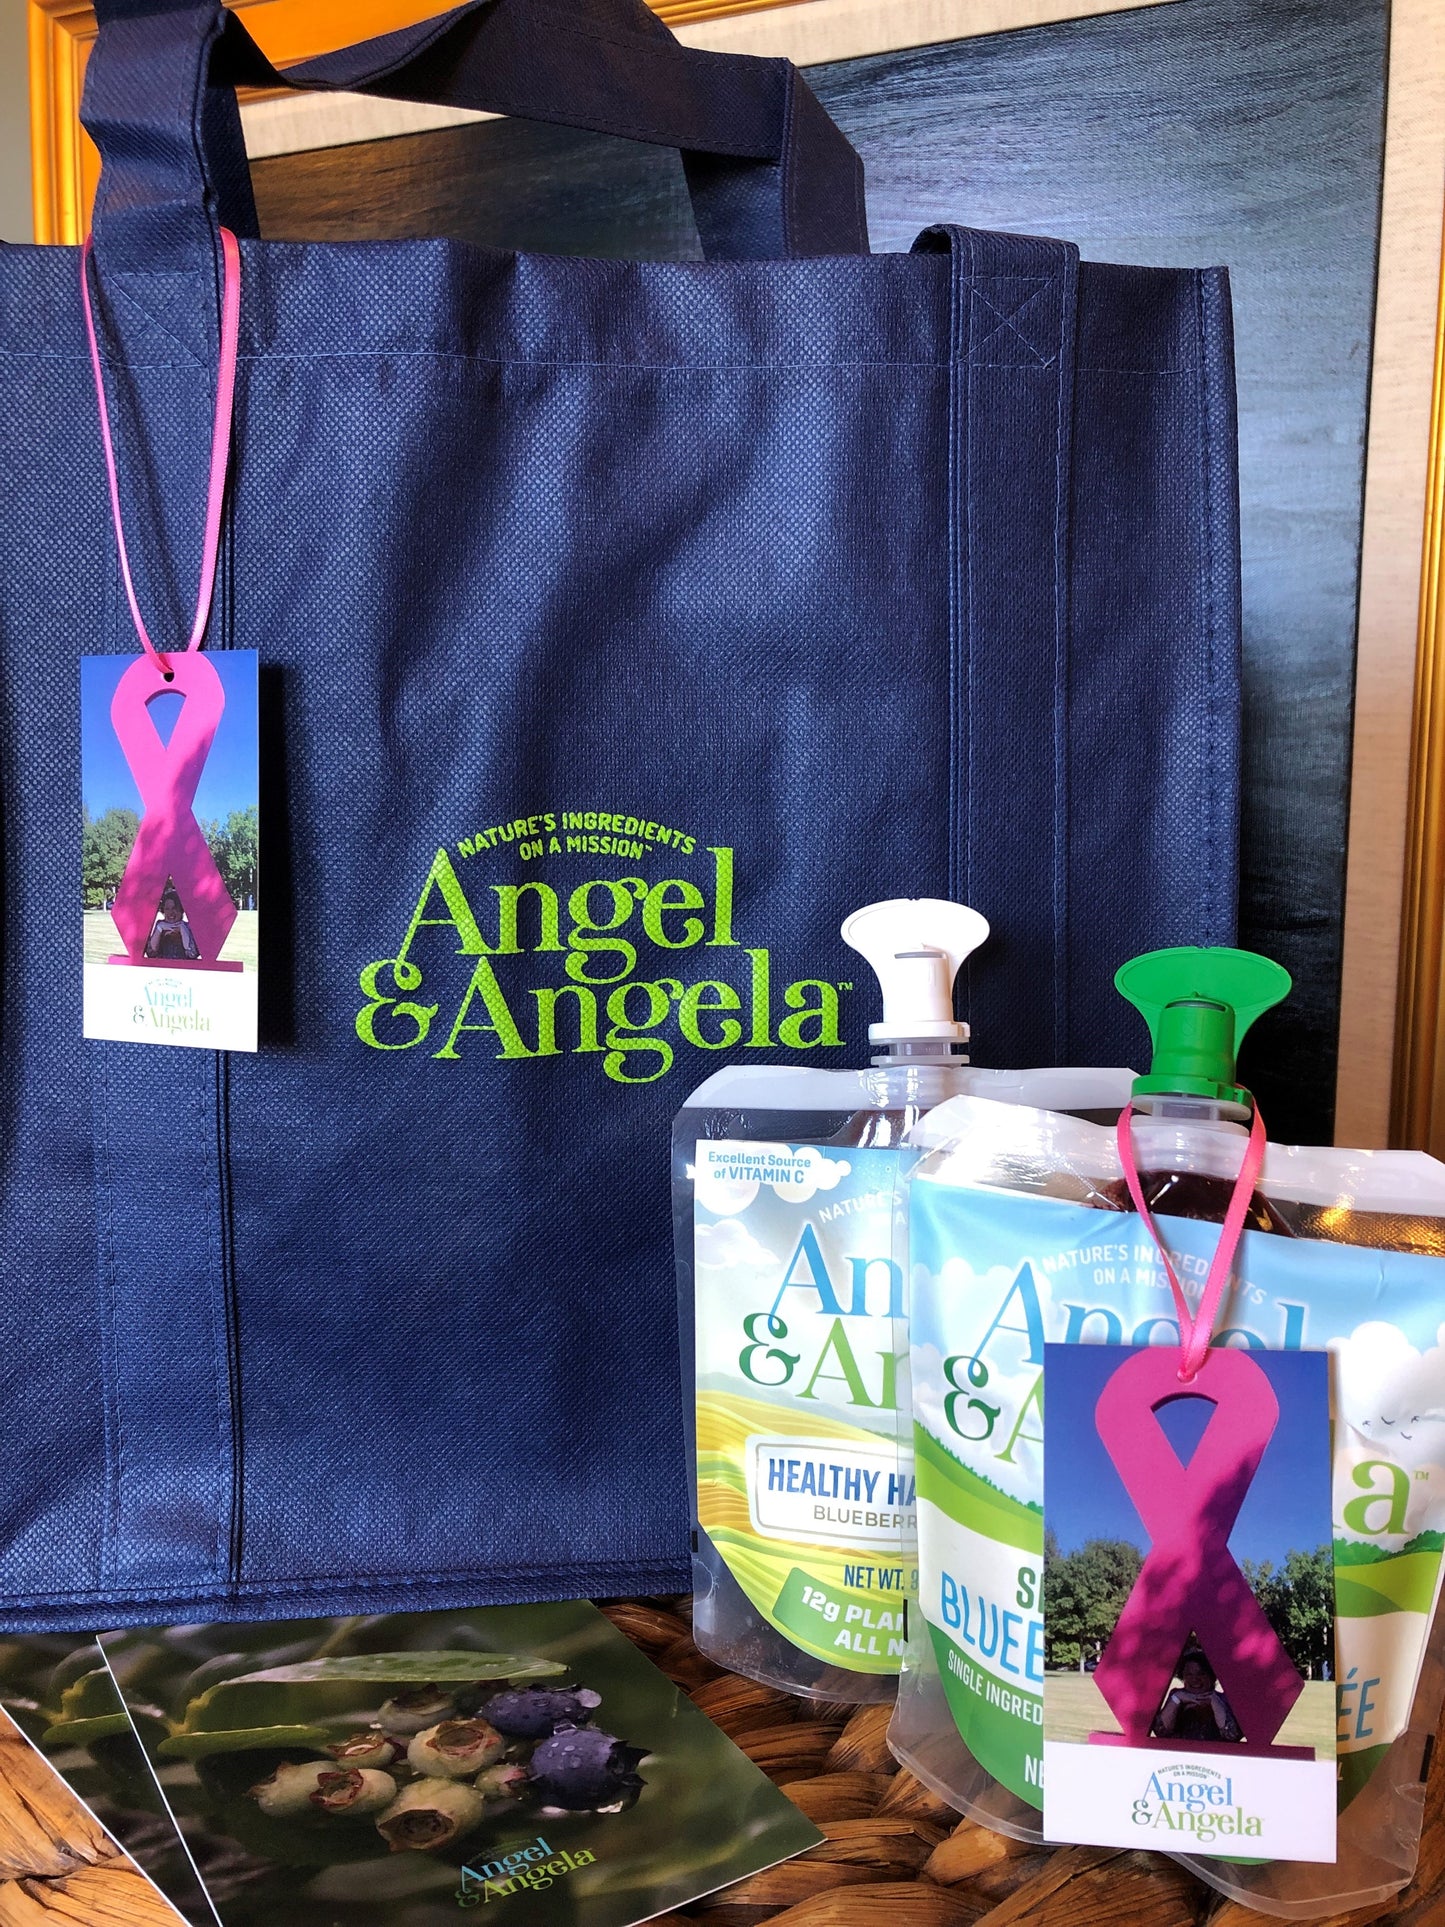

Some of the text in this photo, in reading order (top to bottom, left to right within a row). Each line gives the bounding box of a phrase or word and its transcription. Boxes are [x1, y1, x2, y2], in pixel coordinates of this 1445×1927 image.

[457, 811, 696, 858] NATURE'S INGREDIENTS
[519, 838, 544, 861] ON
[549, 837, 562, 854] A
[395, 846, 741, 985] Angel
[708, 1151, 811, 1168] Excellent Source
[713, 1166, 805, 1184] of VITAMIN C
[1042, 1244, 1129, 1273] NATURE'S
[1094, 1267, 1115, 1286] ON
[1120, 1268, 1131, 1284] A
[768, 1458, 880, 1504] HEALTHY
[844, 1564, 878, 1589] NET
[879, 1567, 904, 1591] WT.
[802, 1586, 841, 1622] 12g
[833, 1629, 880, 1656] ALL
[948, 1648, 983, 1697] SINGLE
[1157, 1764, 1222, 1780] NATURE'S INGREDIENTS
[1142, 1772, 1233, 1814] Angel
[460, 1837, 555, 1894] Angel
[483, 1848, 598, 1904] Angela
